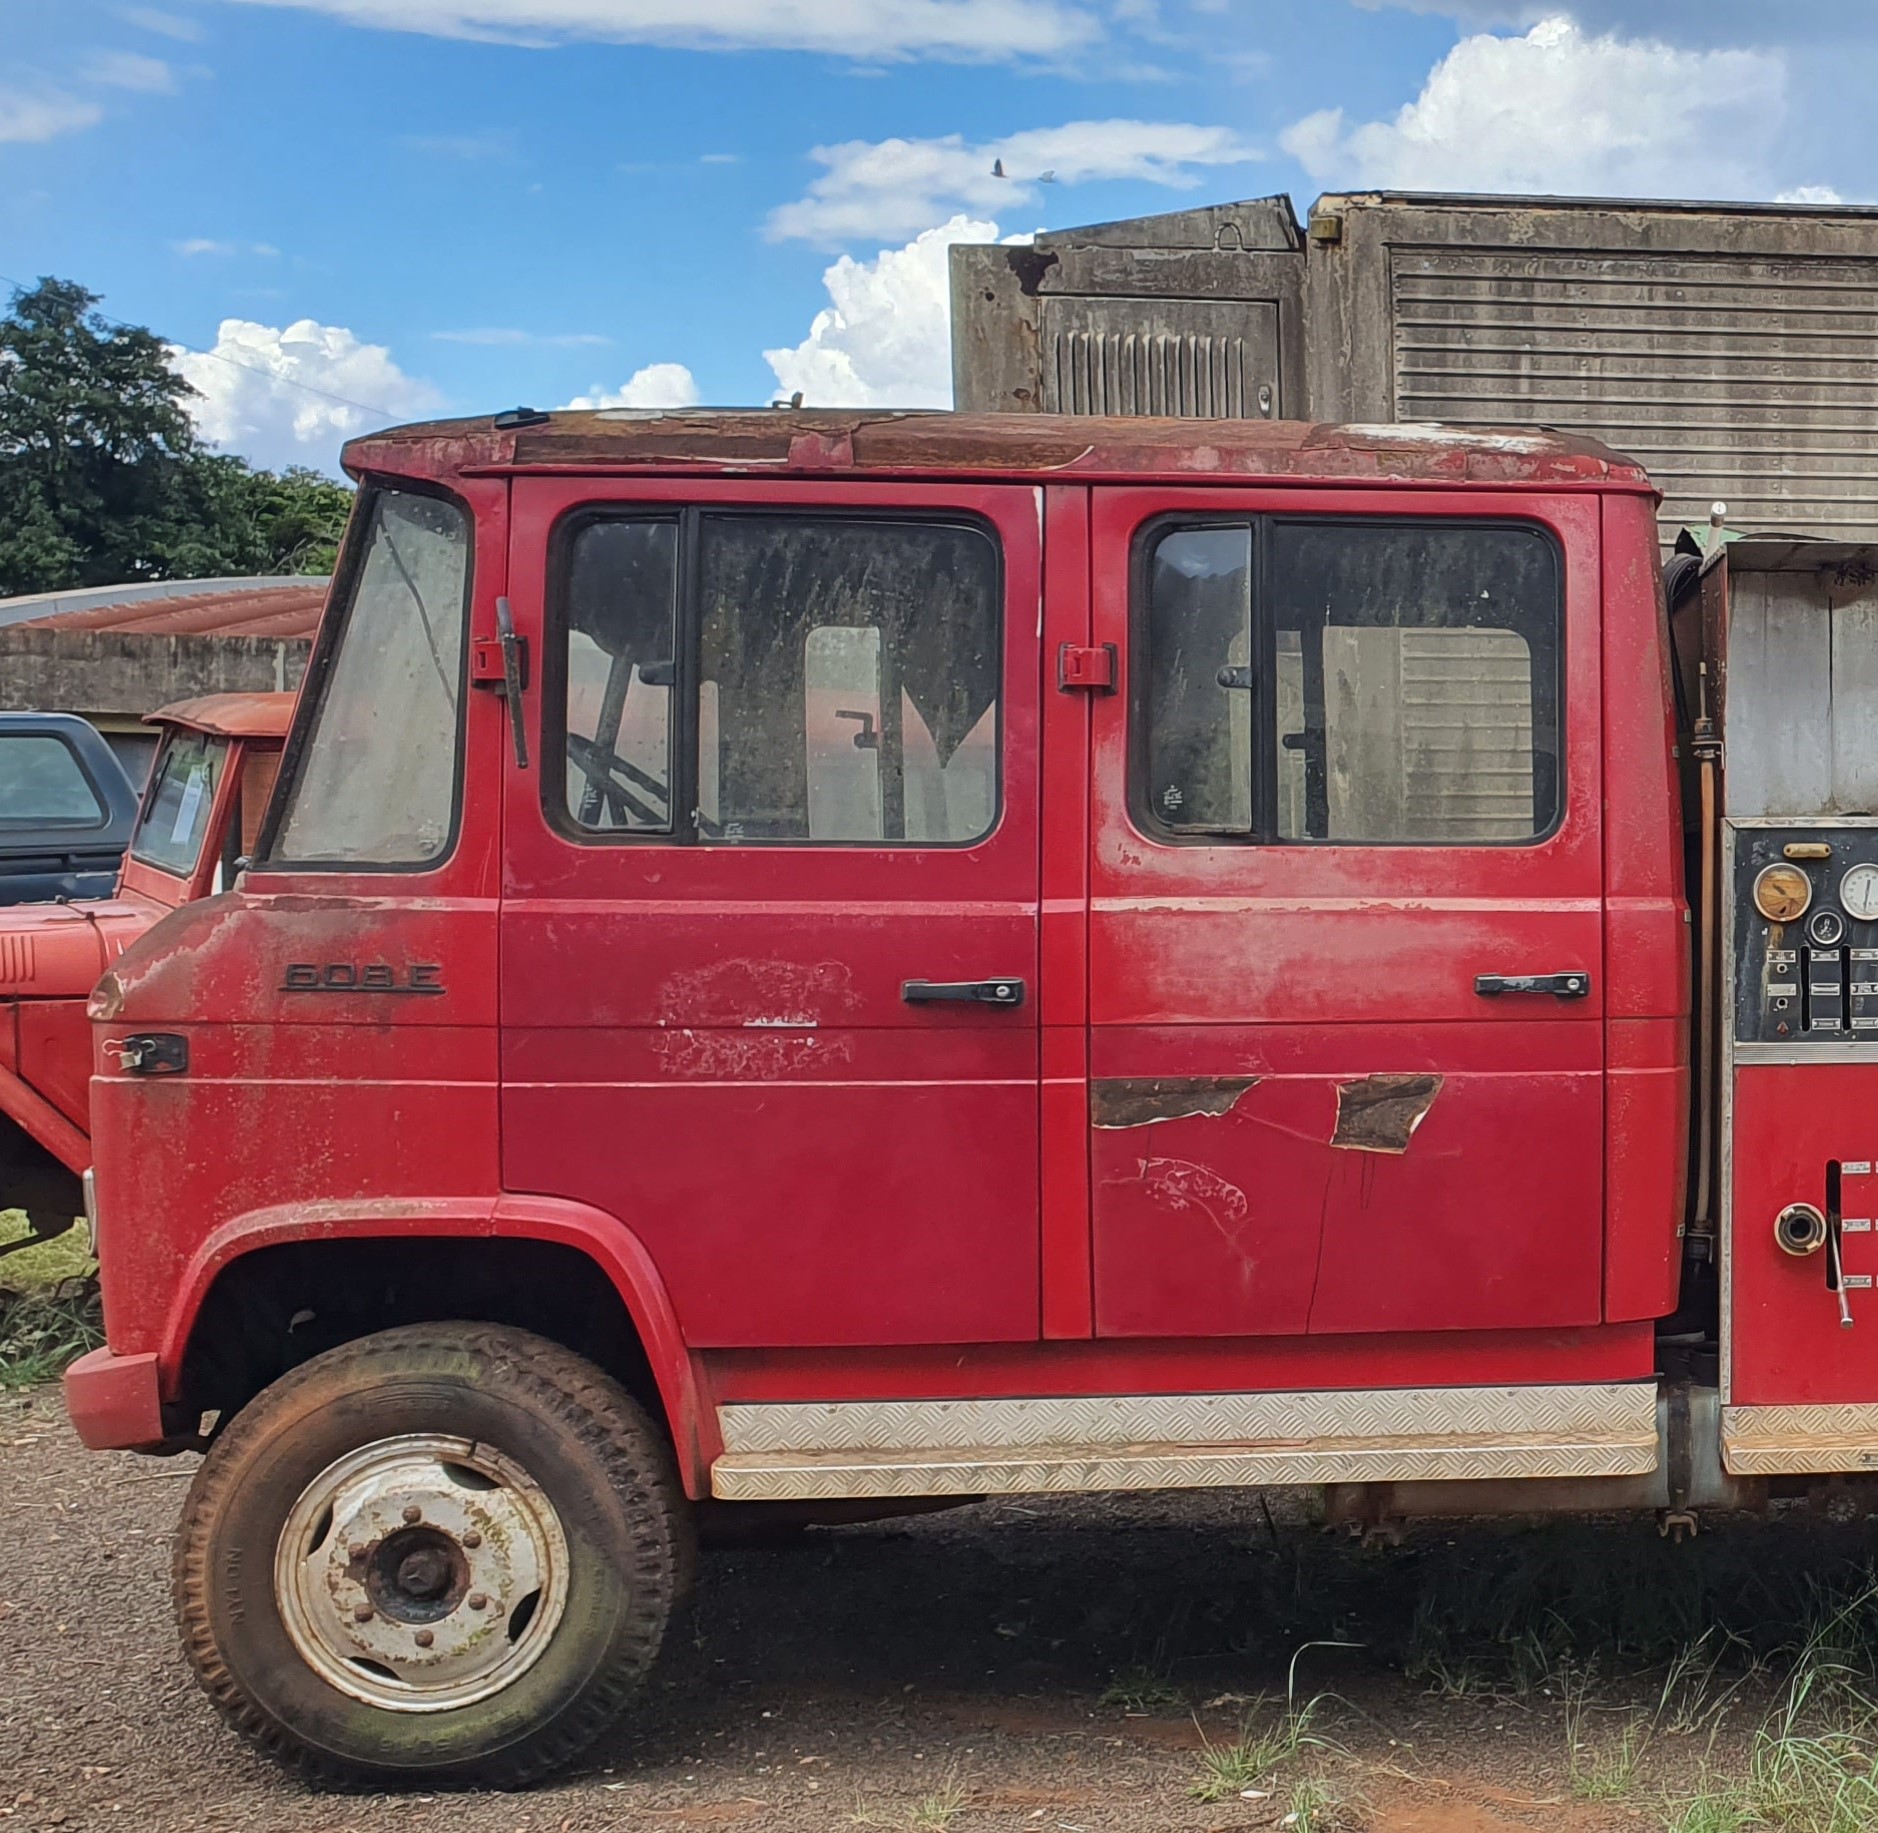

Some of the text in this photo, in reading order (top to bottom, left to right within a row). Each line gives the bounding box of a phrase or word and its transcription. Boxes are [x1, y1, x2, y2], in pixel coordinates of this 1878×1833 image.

[286, 963, 442, 988] 608 E
[225, 1548, 246, 1627] NYLON
